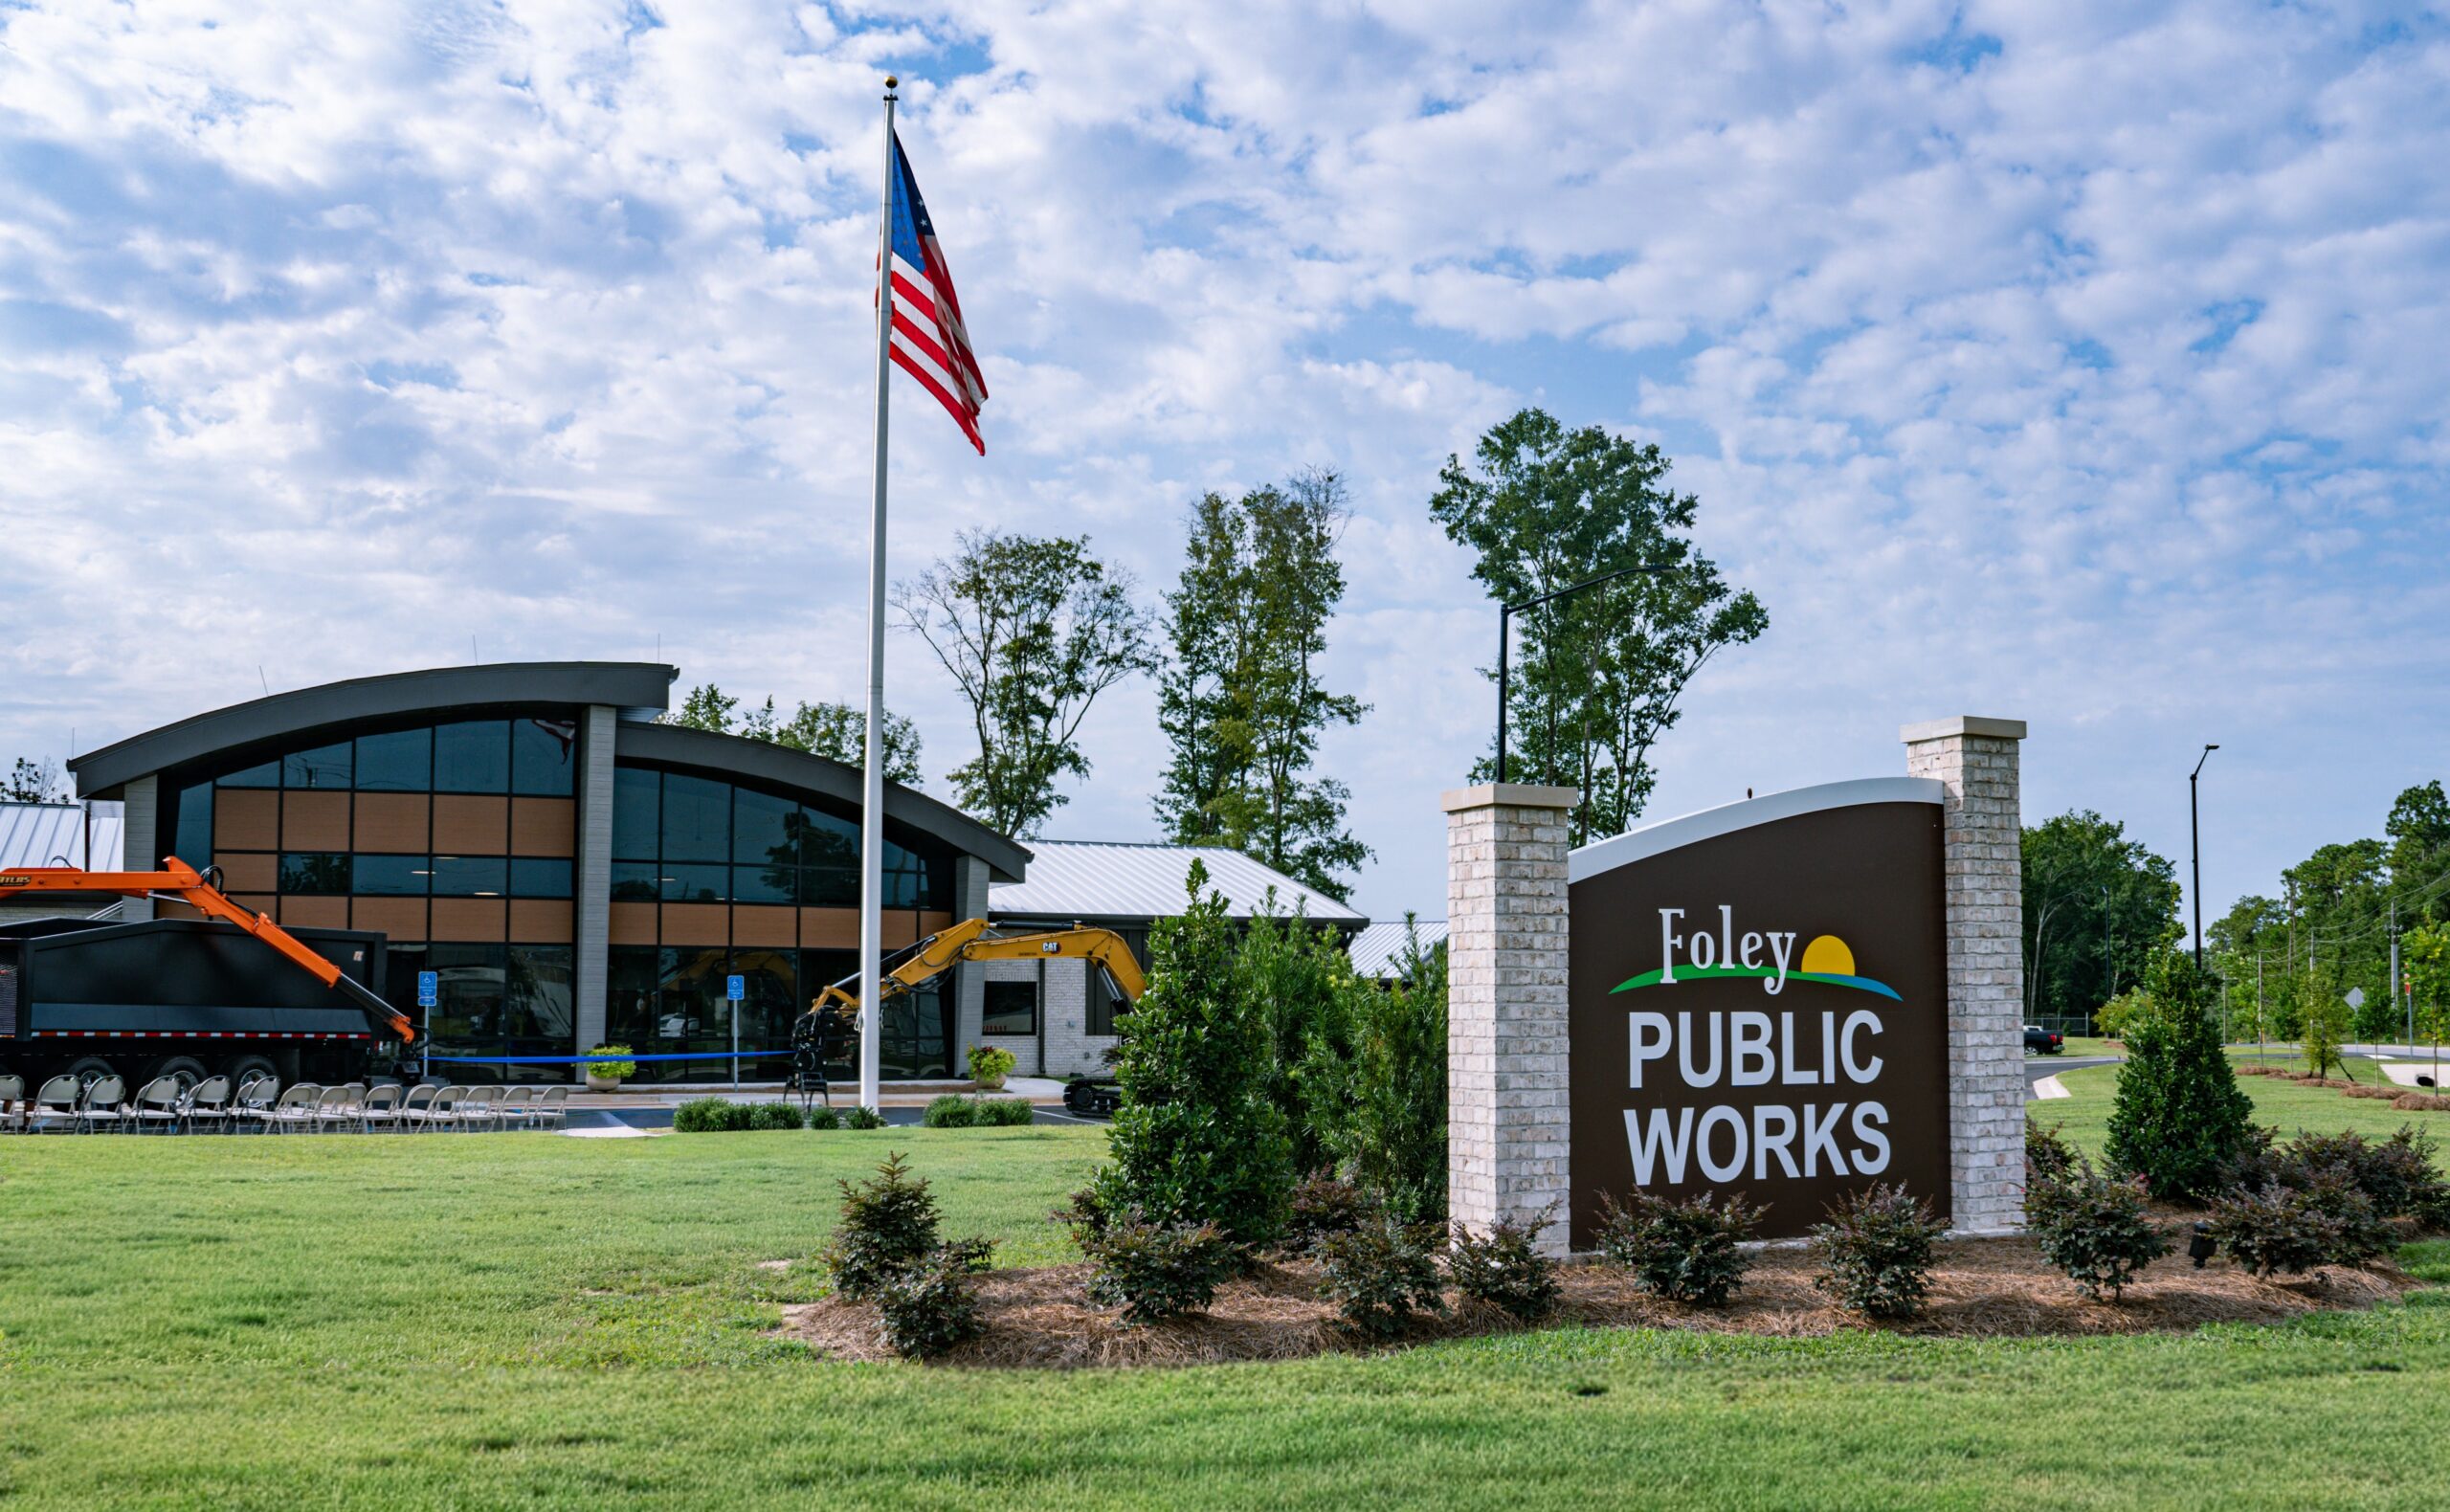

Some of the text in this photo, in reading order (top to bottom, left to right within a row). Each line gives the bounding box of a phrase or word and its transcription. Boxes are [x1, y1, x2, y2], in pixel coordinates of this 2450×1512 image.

[1042, 942, 1058, 952] CAT
[1659, 905, 1796, 995] Foley
[1629, 1010, 1883, 1088] PUBLIC
[1623, 1101, 1891, 1186] WORKS
